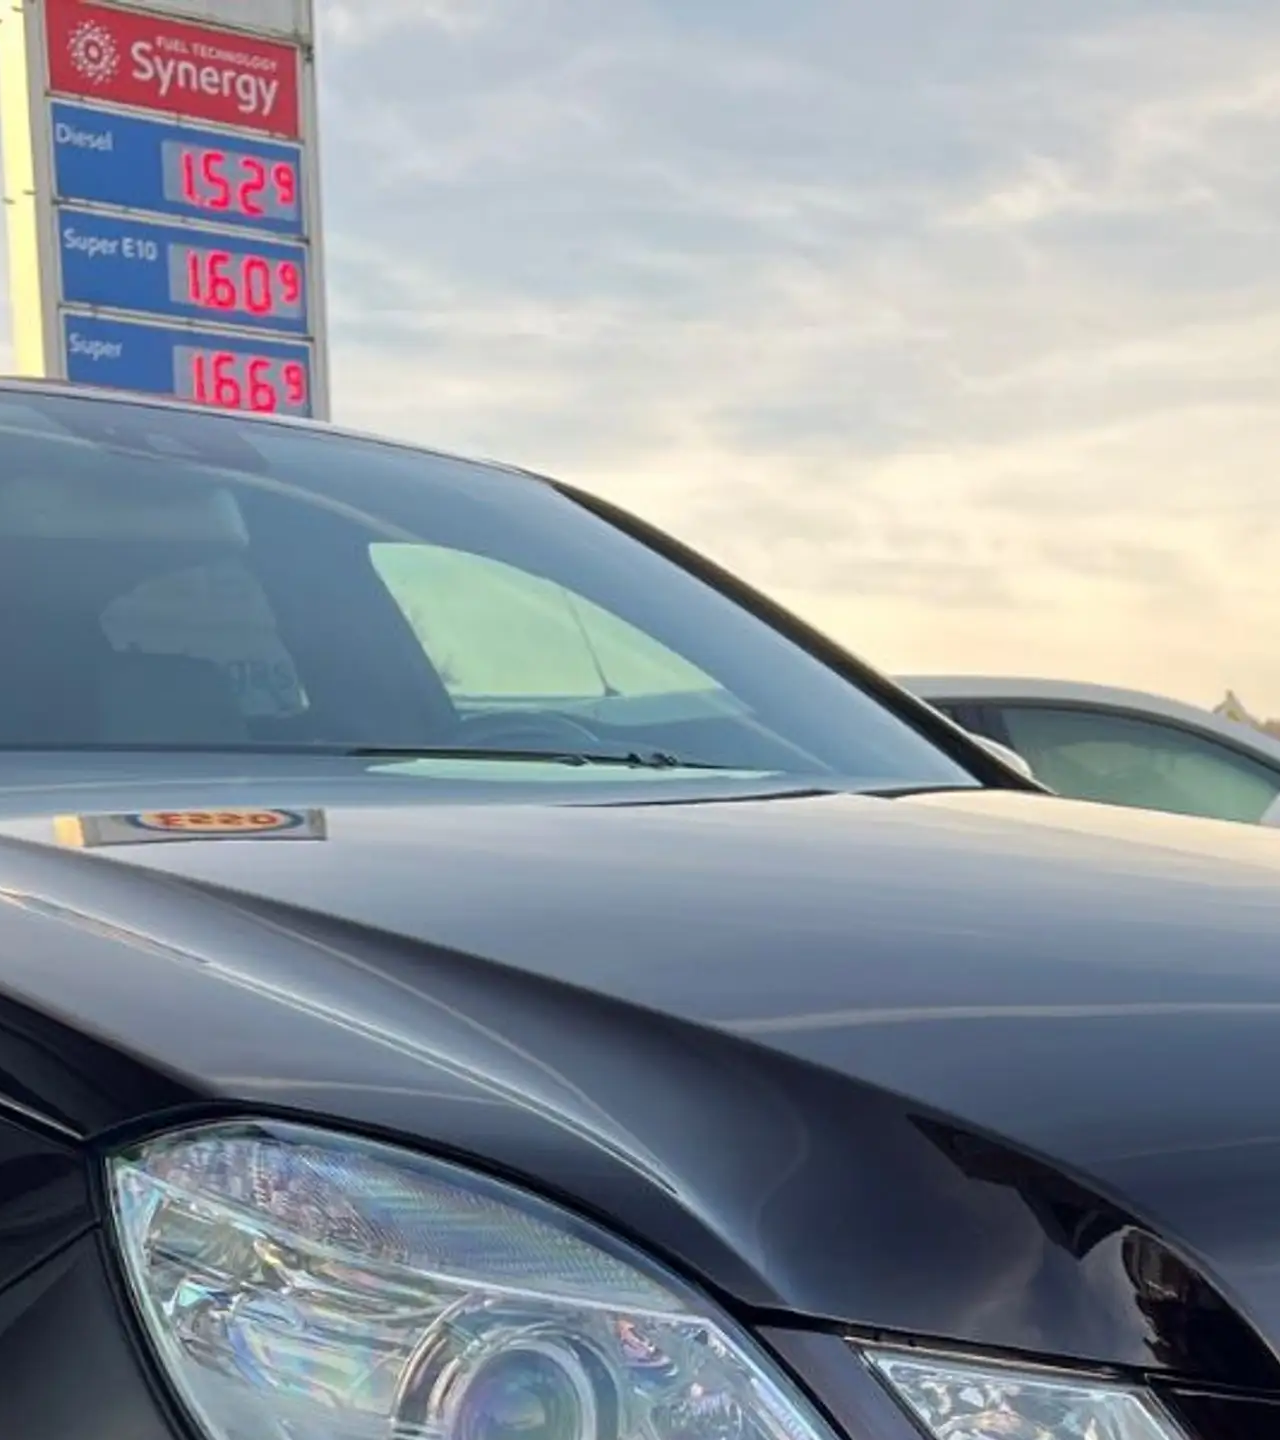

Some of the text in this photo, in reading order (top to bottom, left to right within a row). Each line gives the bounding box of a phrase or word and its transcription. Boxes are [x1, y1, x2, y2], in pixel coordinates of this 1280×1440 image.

[156, 36, 277, 72] FUEL TECHNOLOGY
[131, 40, 279, 116] Synergy
[55, 122, 113, 151] Diesel
[63, 228, 158, 261] Super E10
[69, 332, 122, 363] Super
